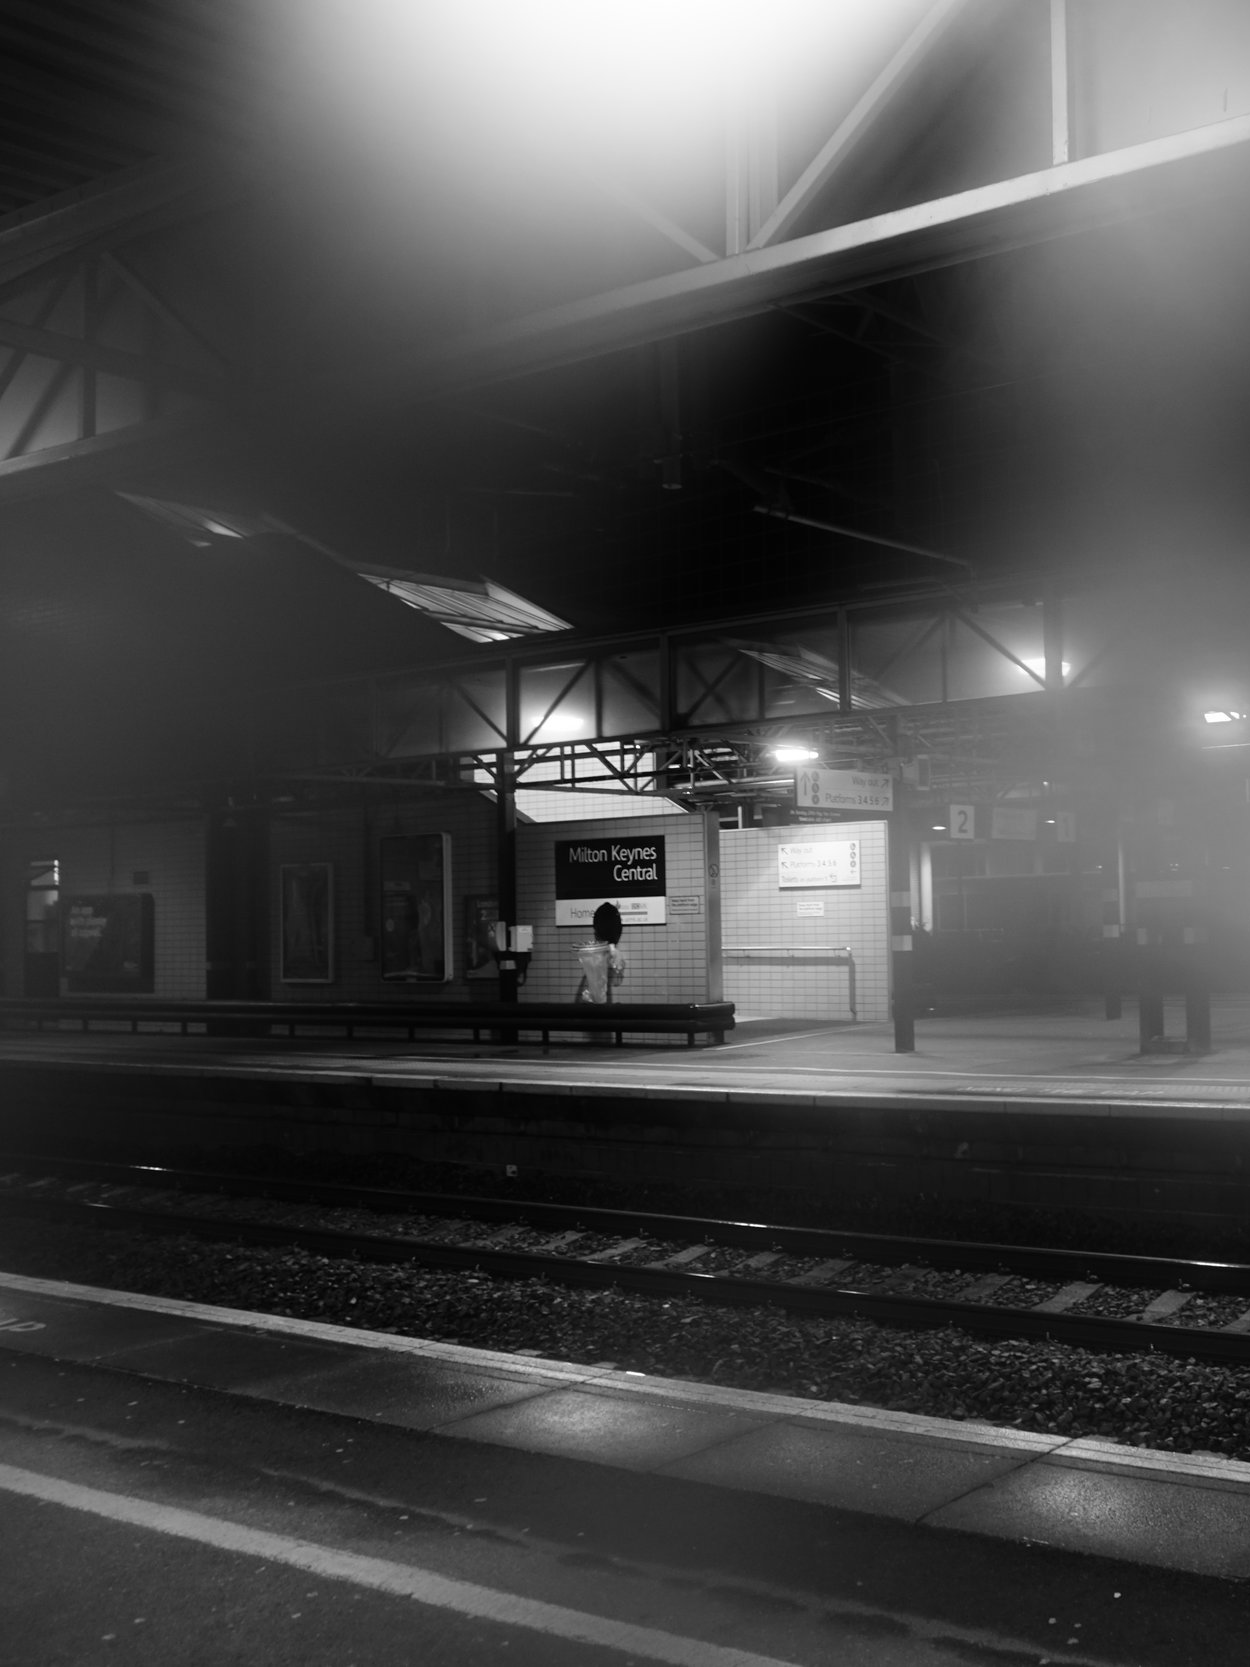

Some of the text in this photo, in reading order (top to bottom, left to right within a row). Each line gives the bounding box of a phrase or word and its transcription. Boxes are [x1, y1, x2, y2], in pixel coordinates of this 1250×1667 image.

[852, 776, 879, 788] Way out
[825, 793, 856, 805] Platforms
[957, 810, 968, 833] 2
[569, 845, 657, 865] Milton Keynes
[613, 863, 658, 882] Central
[570, 907, 595, 919] Home
